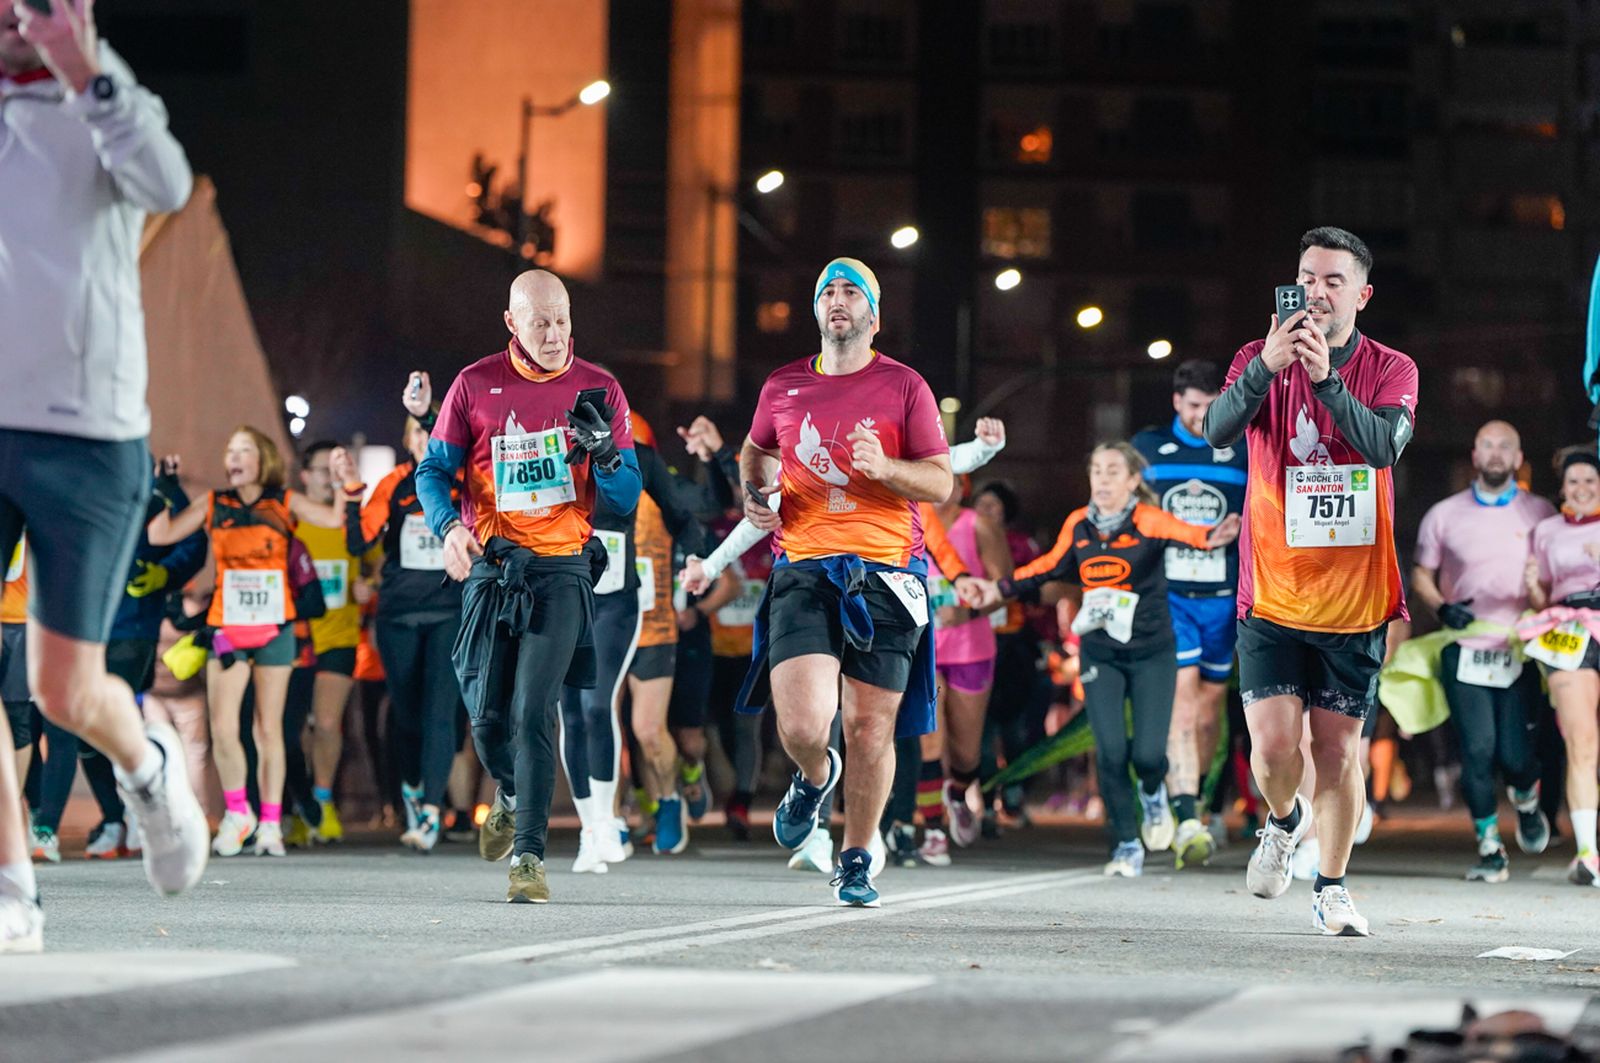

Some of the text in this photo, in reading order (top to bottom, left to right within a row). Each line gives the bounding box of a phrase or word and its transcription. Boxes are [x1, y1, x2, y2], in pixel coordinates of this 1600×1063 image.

[527, 440, 538, 449] DE
[500, 452, 515, 462] SAN
[810, 453, 830, 474] 43
[507, 457, 556, 485] 7850
[1306, 474, 1344, 483] NOCHE DE
[1296, 485, 1313, 493] SAN
[1307, 494, 1355, 519] 7571
[239, 590, 269, 606] 7317
